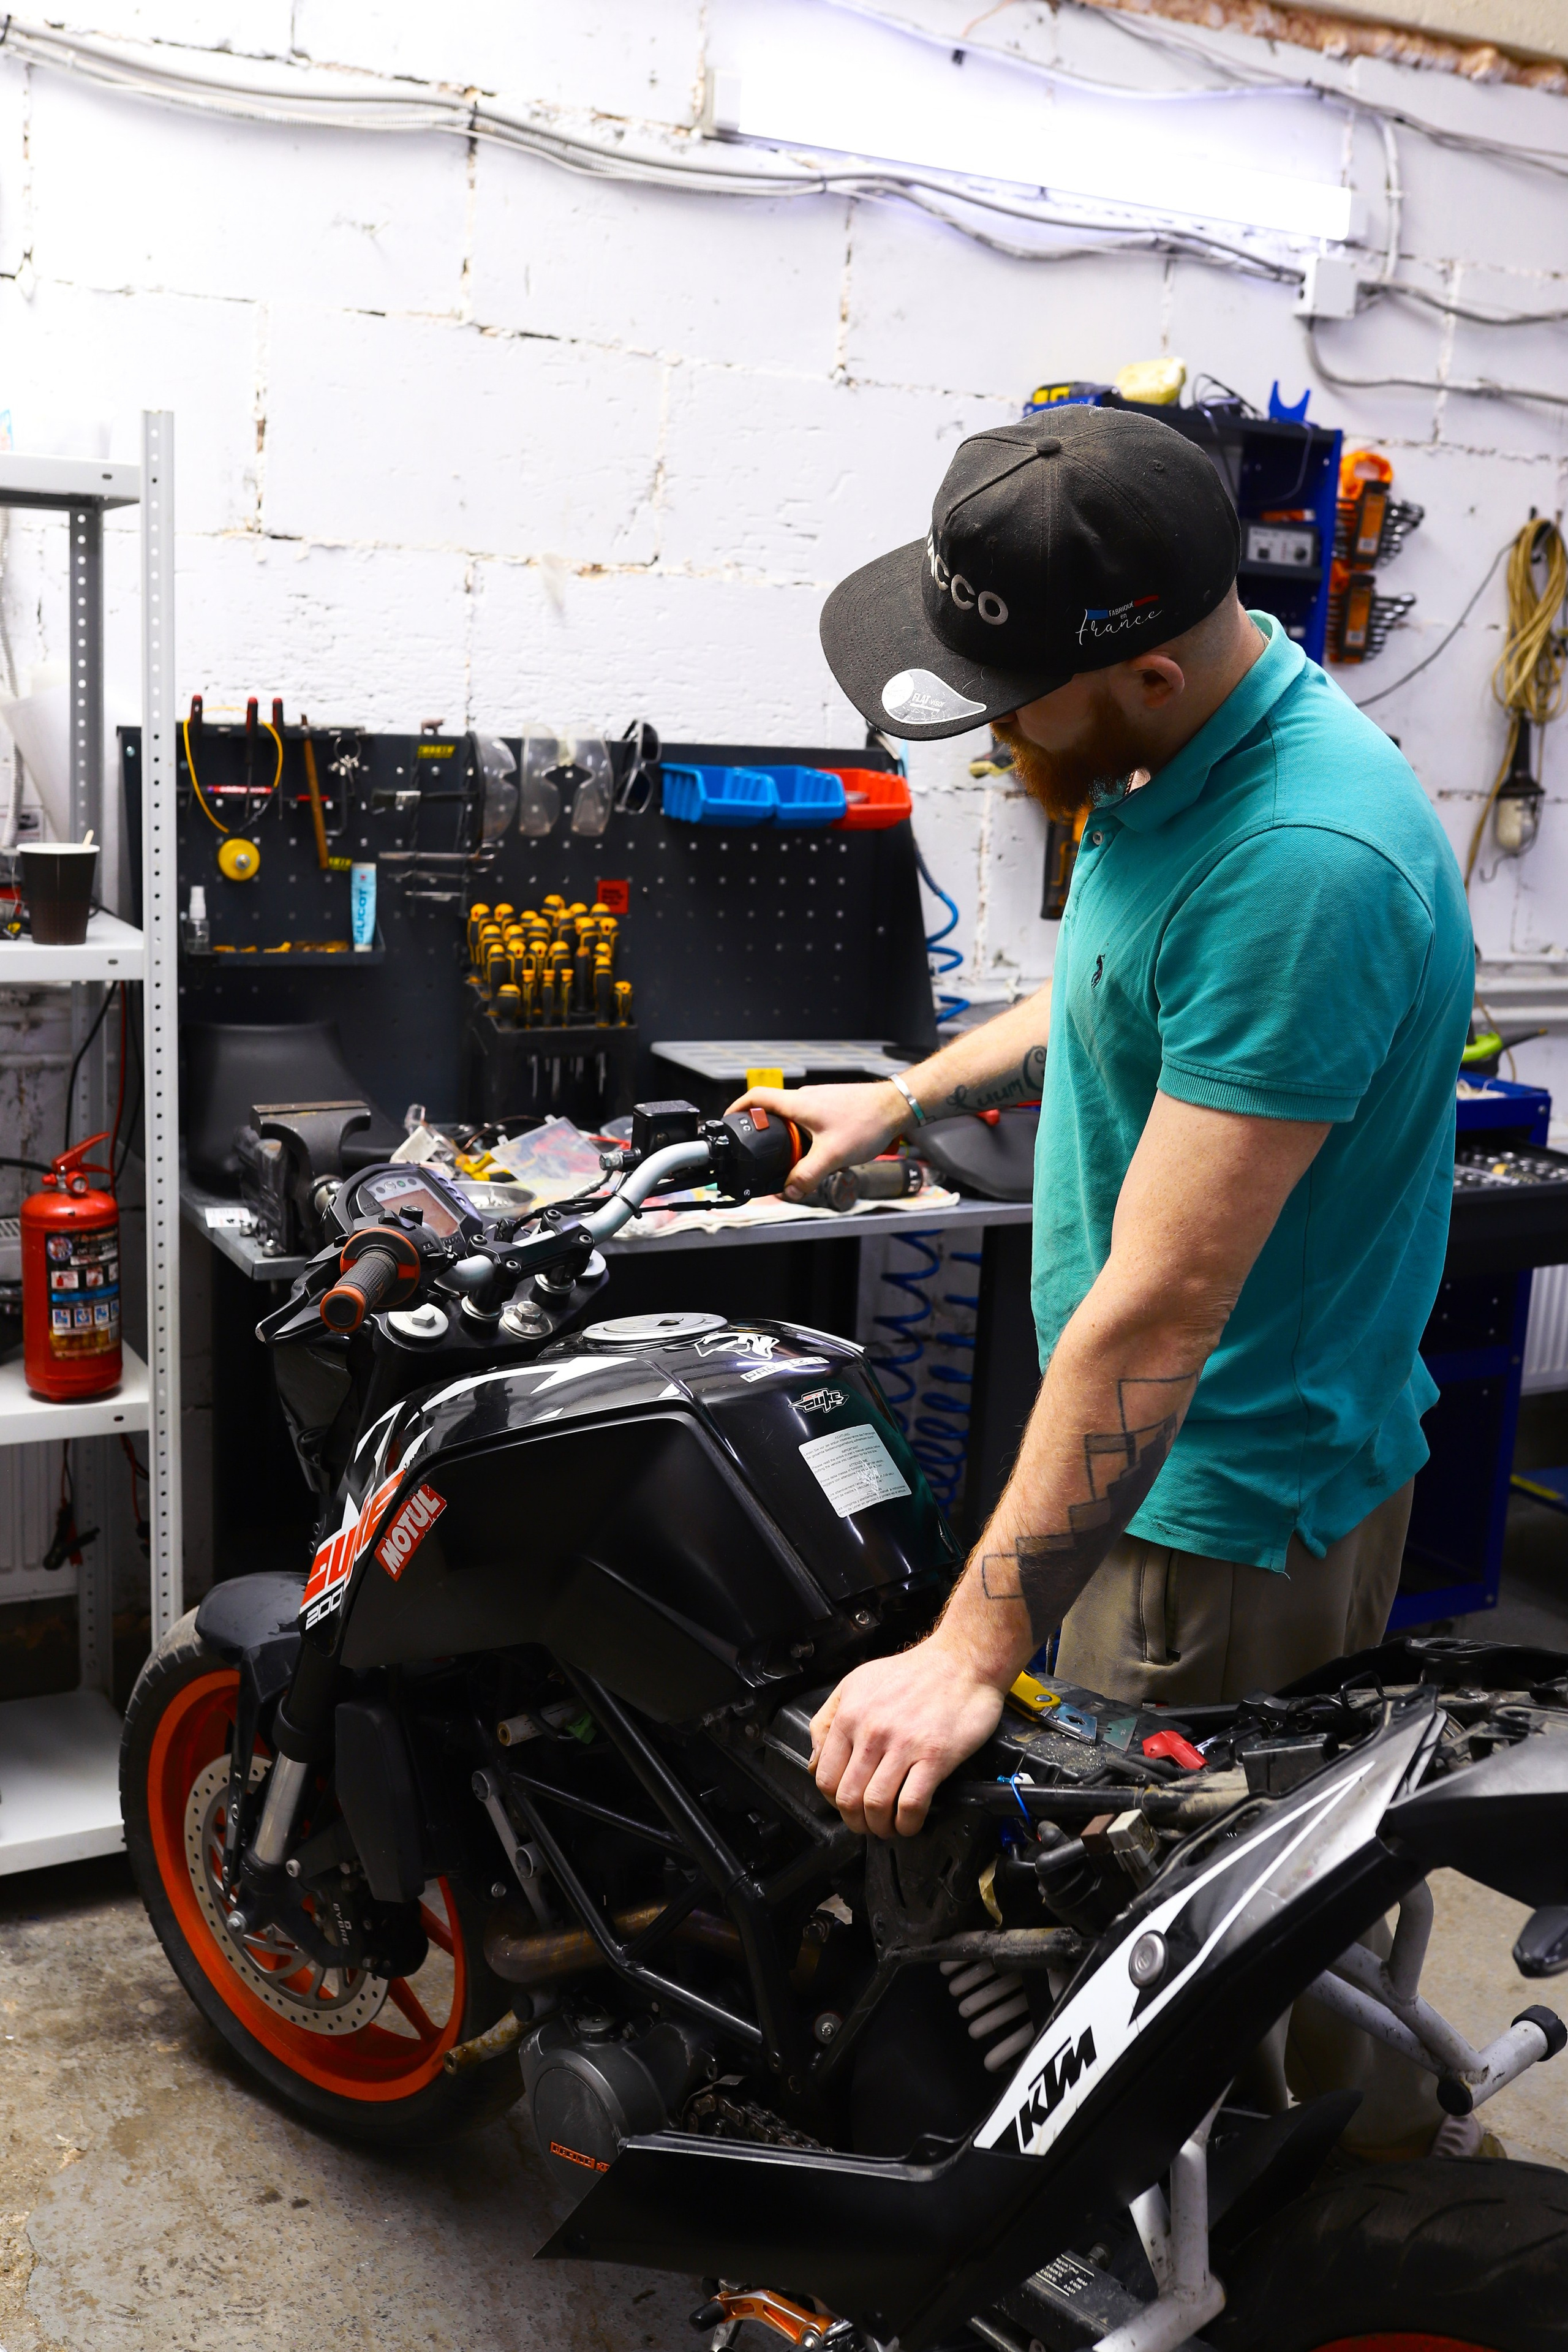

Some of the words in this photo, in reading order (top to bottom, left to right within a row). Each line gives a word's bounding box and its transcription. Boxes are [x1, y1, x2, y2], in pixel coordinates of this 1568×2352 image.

[912, 692, 931, 704] FLAT
[930, 699, 948, 707] visor
[380, 1489, 440, 1575] MOTUL
[306, 1586, 344, 1630] 200
[333, 1903, 350, 1946] BYBRE
[1019, 2025, 1097, 2149] KTM
